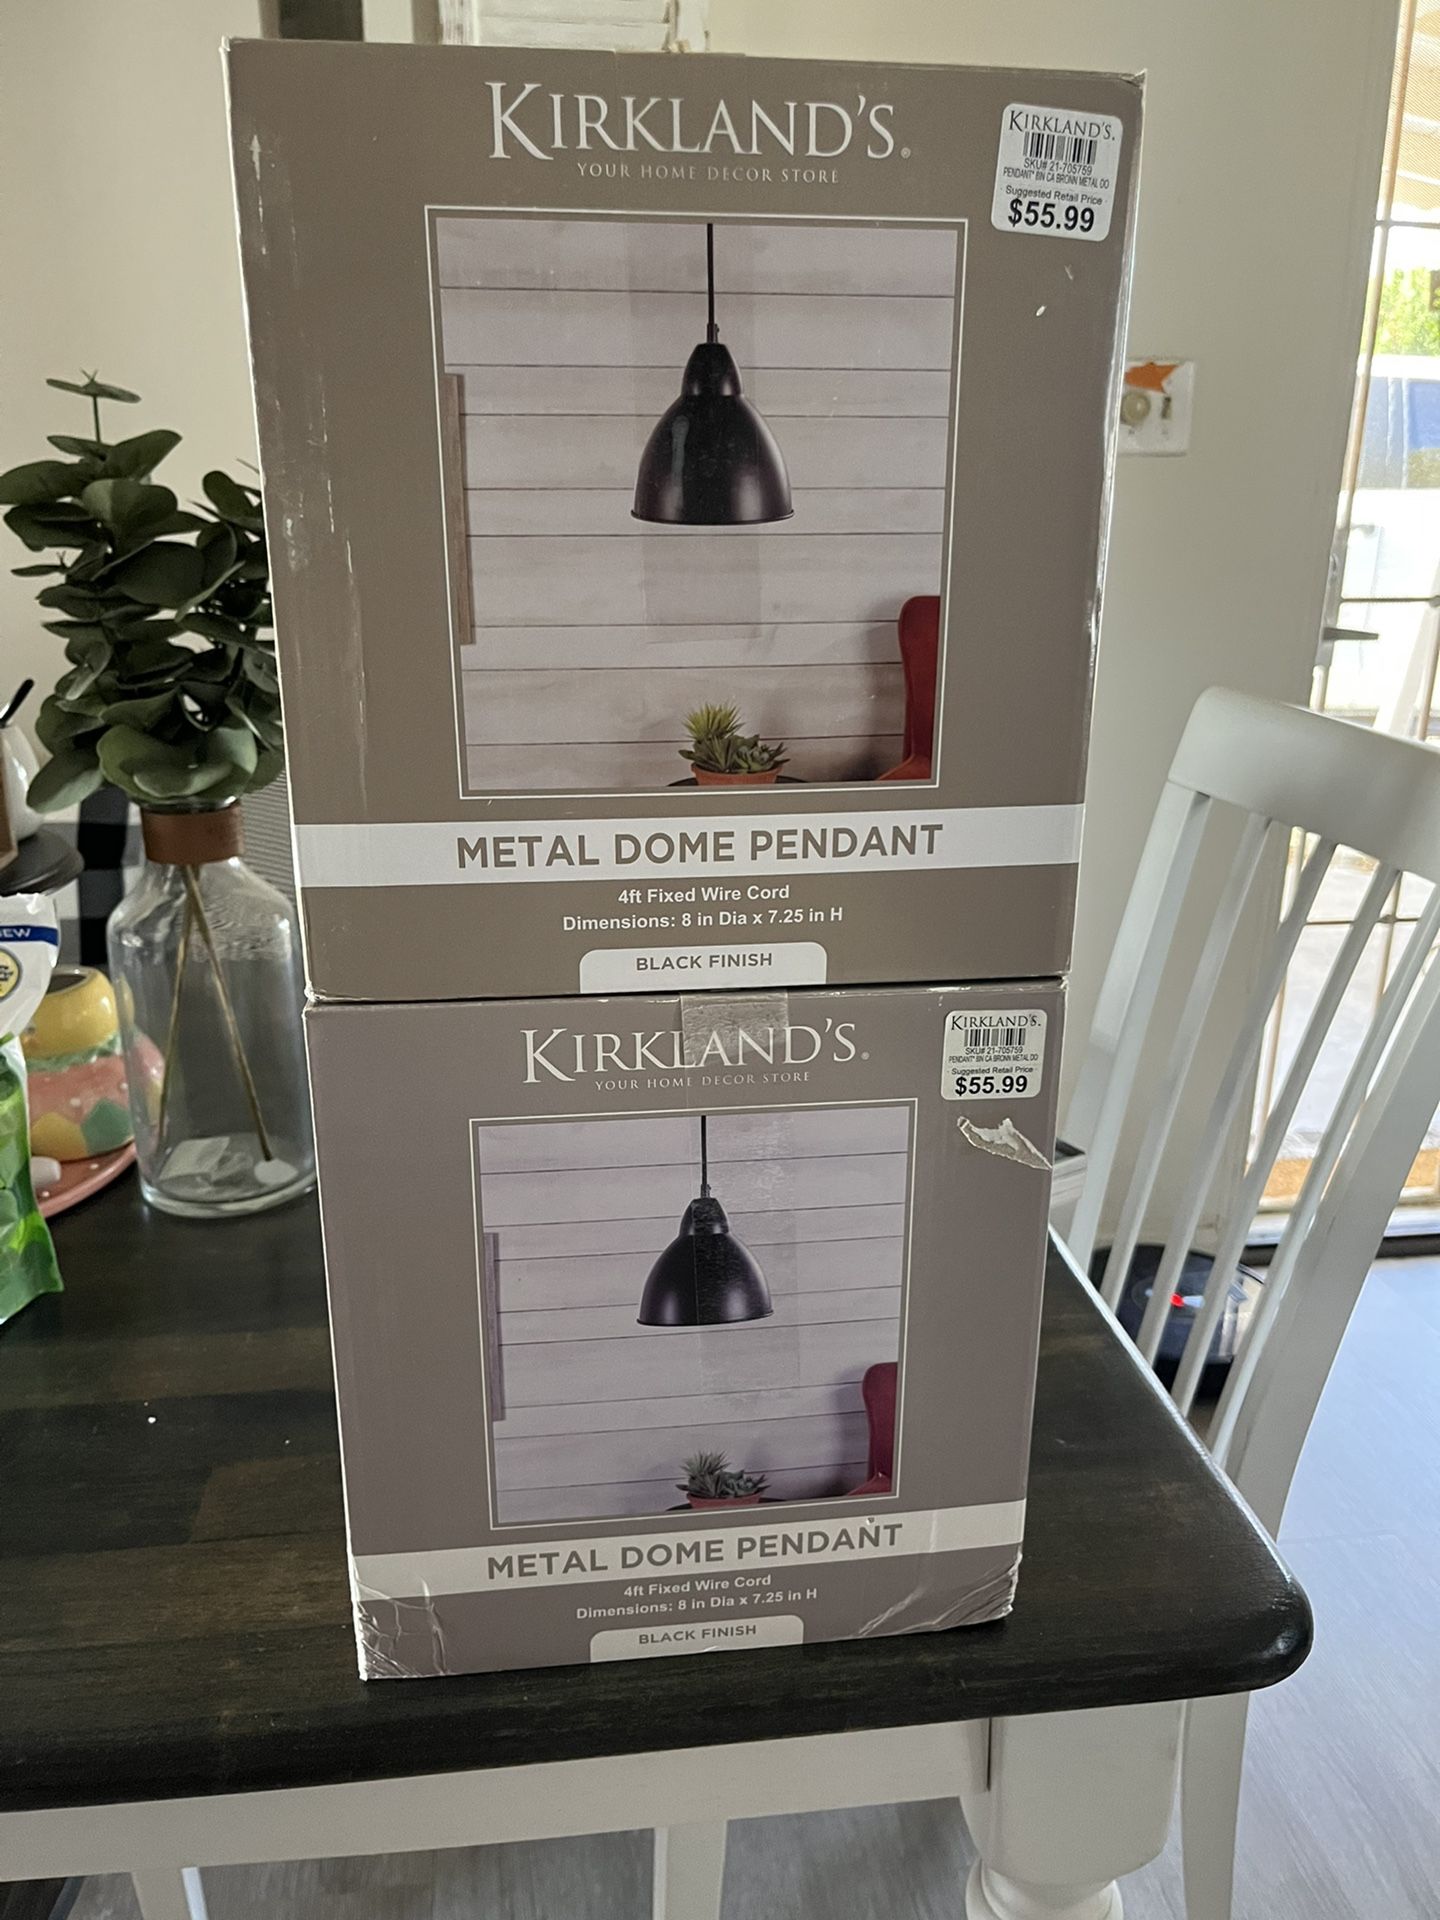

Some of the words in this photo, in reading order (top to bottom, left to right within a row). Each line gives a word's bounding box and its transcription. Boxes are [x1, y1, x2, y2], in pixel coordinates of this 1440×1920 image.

[577, 162, 630, 178] YOUR
[640, 165, 696, 181] HOME
[708, 167, 772, 183] DECOR
[782, 168, 838, 184] STORE
[1024, 158, 1047, 170] SKU#
[1049, 161, 1093, 176] 21-705759
[1005, 185, 1052, 199] Suggested
[1054, 190, 1079, 202] Retail
[1081, 194, 1102, 206] Price
[1008, 197, 1095, 232] $55.99
[457, 835, 599, 868] METAL
[615, 831, 735, 865] DOME
[750, 824, 943, 861] PENDANT
[618, 889, 642, 905] 4ft
[647, 887, 696, 903] Fixed
[701, 886, 742, 901] Wire
[747, 884, 790, 900] Cord
[563, 914, 676, 931] Dimensions:
[681, 912, 692, 927] 8
[697, 911, 713, 927] in
[719, 910, 747, 926] Dia
[752, 913, 763, 925] x
[768, 908, 803, 924] 7.25
[809, 907, 824, 923] in
[830, 907, 843, 922] H
[636, 955, 702, 971] BLACK
[709, 952, 773, 968] FINISH
[965, 1047, 986, 1055] SKU#
[987, 1046, 1023, 1054] 21-705759
[595, 1078, 639, 1091] YOUR
[647, 1076, 693, 1089] HOME
[702, 1074, 756, 1087] DECOR
[762, 1071, 811, 1084] STORE
[951, 1067, 990, 1076] Suggested
[992, 1066, 1013, 1074] Retail
[1015, 1065, 1034, 1073] Price
[955, 1075, 1028, 1096] $55.99
[487, 1549, 608, 1580] METAL
[621, 1539, 724, 1569] DOME
[737, 1523, 903, 1560] PENDANT
[624, 1583, 644, 1598] 4ft
[648, 1581, 690, 1596] Fixed
[695, 1577, 730, 1591] Wire
[734, 1574, 772, 1588] Cord
[576, 1602, 673, 1620] Dimensions:
[678, 1599, 688, 1611] 8
[691, 1597, 706, 1610] in
[710, 1595, 736, 1608] Dia
[739, 1595, 749, 1606] x
[752, 1591, 784, 1605] 7.25
[788, 1589, 801, 1602] in
[806, 1588, 818, 1600] H
[638, 1629, 696, 1645] BLACK
[701, 1624, 757, 1640] FINISH
